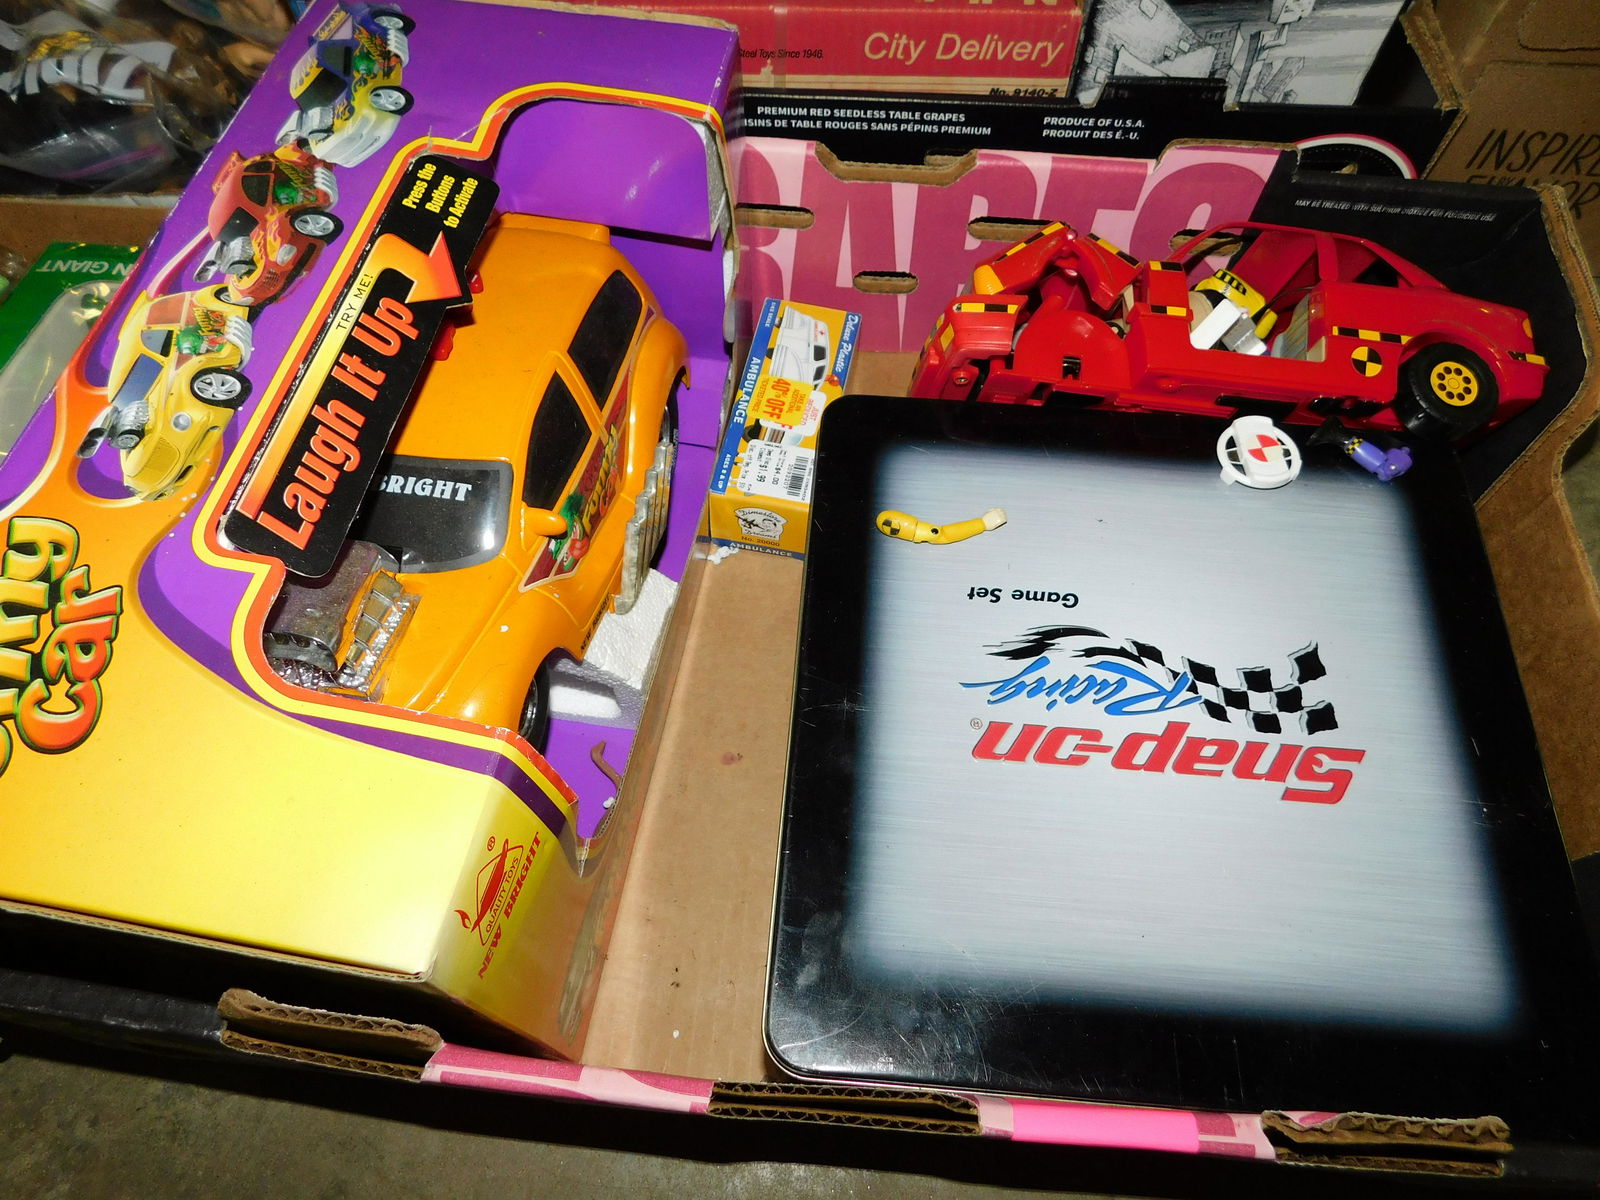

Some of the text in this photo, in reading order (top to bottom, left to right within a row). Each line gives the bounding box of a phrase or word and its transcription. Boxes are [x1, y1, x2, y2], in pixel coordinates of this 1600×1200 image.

[760, 48, 775, 60] Toys
[778, 48, 800, 59] Since
[864, 32, 1064, 66] City Delivery
[744, 118, 992, 136] ISINS DE TABLE ROUGES SANS PÉPINS PREMIUM
[757, 106, 966, 122] PREMIUM RED SEEDLESS TABLE GRAPES
[1043, 116, 1146, 128] PRODUCE OF U.S.A.
[1042, 129, 1091, 139] PRODUIT
[1093, 130, 1113, 139] DES
[402, 162, 437, 209] Press the
[425, 174, 456, 214] Buttons
[443, 177, 479, 229] to Activate
[1295, 199, 1311, 208] MAY
[1311, 200, 1321, 208] BE
[1321, 200, 1351, 211] TREATED
[36, 260, 134, 276] N GIANT
[336, 273, 374, 331] TRY ME!
[835, 314, 858, 373] Deluxe Plastic
[734, 356, 761, 424] AMBULANCE
[256, 297, 421, 550] Laugh It Up
[763, 398, 785, 419] OFF
[722, 453, 731, 469] AGES
[717, 480, 724, 489] UP
[729, 541, 793, 557] AMBULANCE
[967, 586, 1079, 609] Game Set
[15, 564, 123, 754] Car
[958, 655, 1205, 716] Racing
[971, 720, 1367, 804] Snap-on
[478, 832, 541, 980] NEW BRIGHT
[486, 857, 519, 933] QUALITY TOYS
